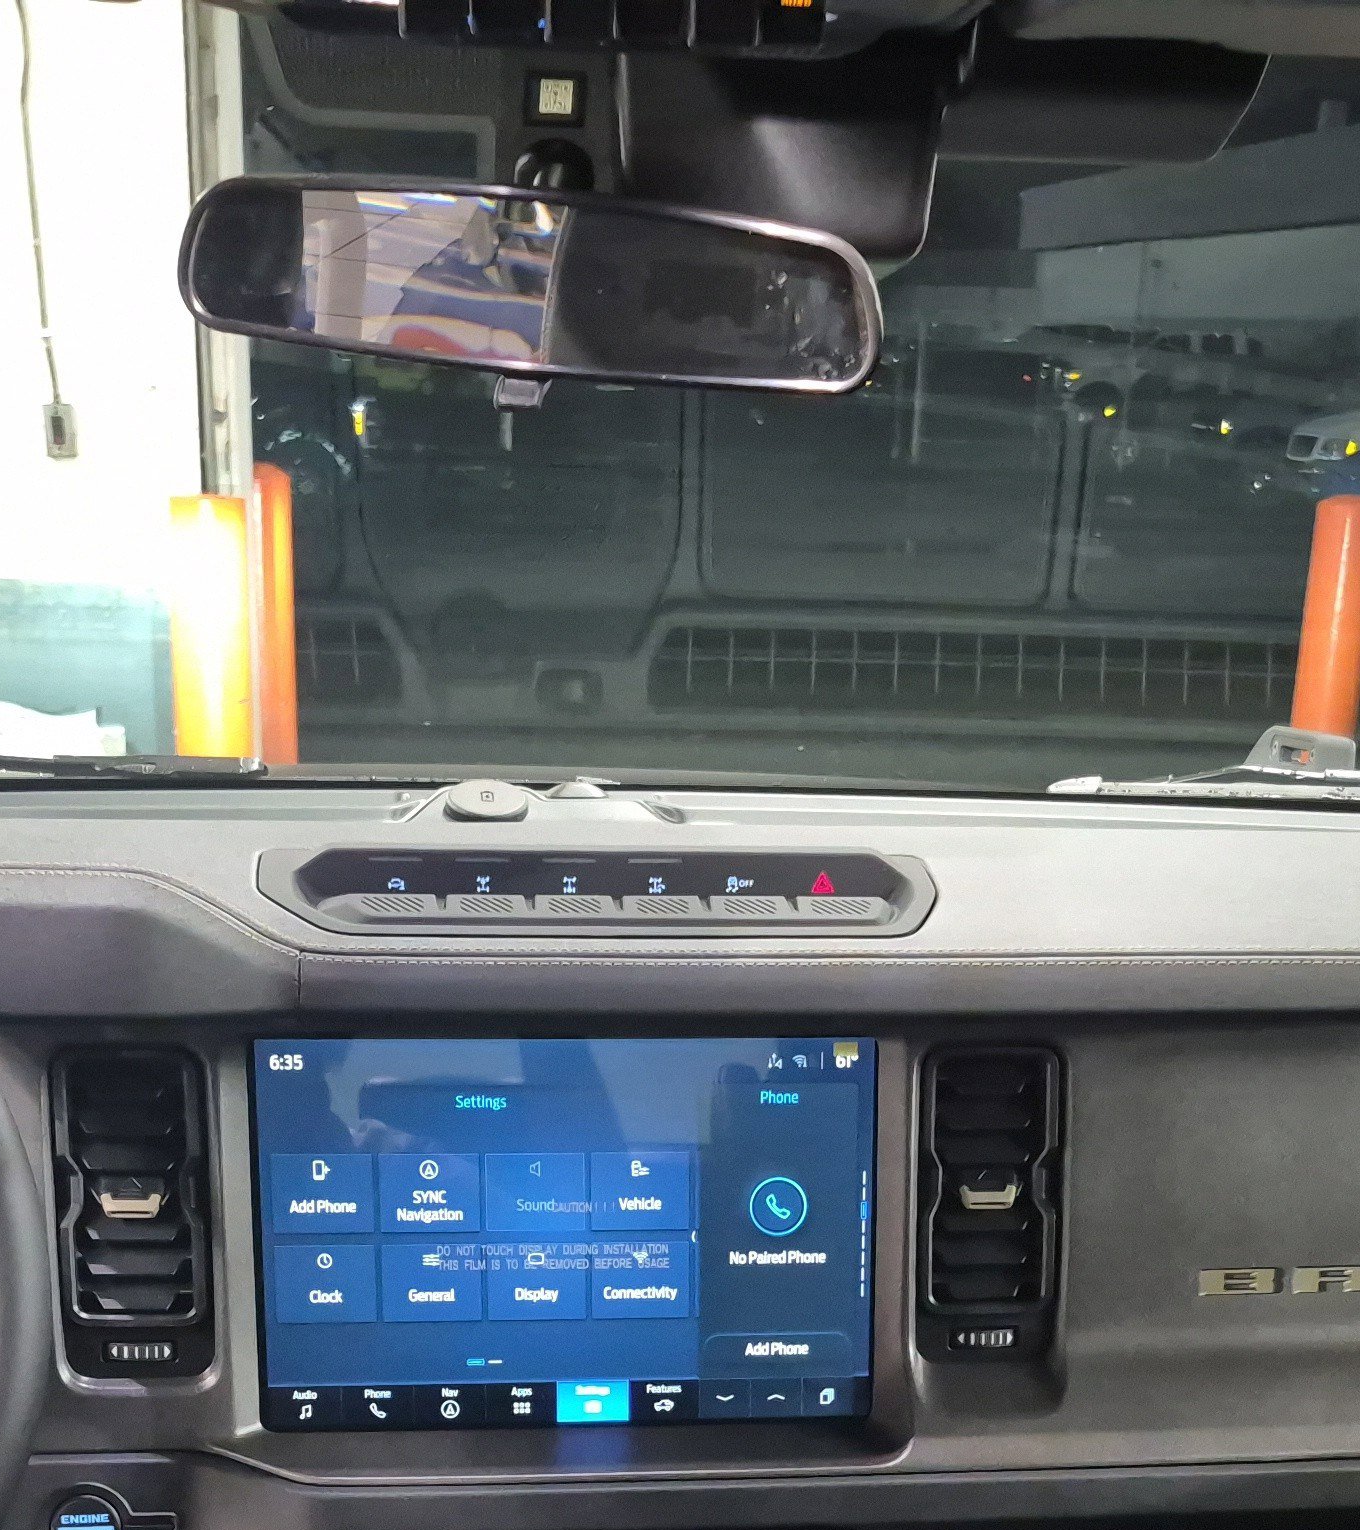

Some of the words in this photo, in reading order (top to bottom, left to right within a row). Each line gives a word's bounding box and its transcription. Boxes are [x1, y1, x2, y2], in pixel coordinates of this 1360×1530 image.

[738, 879, 754, 888] OFF
[269, 1054, 303, 1071] 6:35
[454, 1094, 507, 1110] Settings
[760, 1090, 799, 1104] Phone
[412, 1190, 447, 1205] SYNC
[516, 1198, 554, 1212] Sound
[618, 1196, 662, 1211] Vehicle
[289, 1199, 316, 1214] Add
[317, 1199, 357, 1214] Phone
[396, 1208, 464, 1223] Navigation
[437, 1245, 451, 1256] DO
[456, 1245, 476, 1256] NOT
[481, 1245, 513, 1256] TOUCH
[563, 1244, 598, 1255] DURING
[603, 1243, 669, 1255] INSTALLATION
[439, 1260, 459, 1271] THIS
[464, 1259, 486, 1270] FILM
[491, 1259, 501, 1270] IS
[506, 1259, 518, 1270] TO
[544, 1258, 589, 1270] REMOVED
[594, 1258, 633, 1269] BEFORE
[637, 1258, 670, 1269] USAGE
[729, 1251, 747, 1265] No
[748, 1250, 786, 1265] Paired
[788, 1250, 827, 1264] Phone
[309, 1289, 343, 1304] Clock
[408, 1288, 456, 1303] General
[514, 1287, 559, 1303] Display
[603, 1285, 678, 1301] Connectivity
[744, 1342, 769, 1356] Add
[770, 1341, 810, 1356] Phone
[292, 1389, 318, 1400] Audio
[364, 1388, 392, 1399] Phone
[441, 1387, 459, 1398] Nav
[510, 1386, 533, 1398] Apps
[646, 1383, 682, 1395] Features
[60, 1513, 110, 1524] ENGINE
